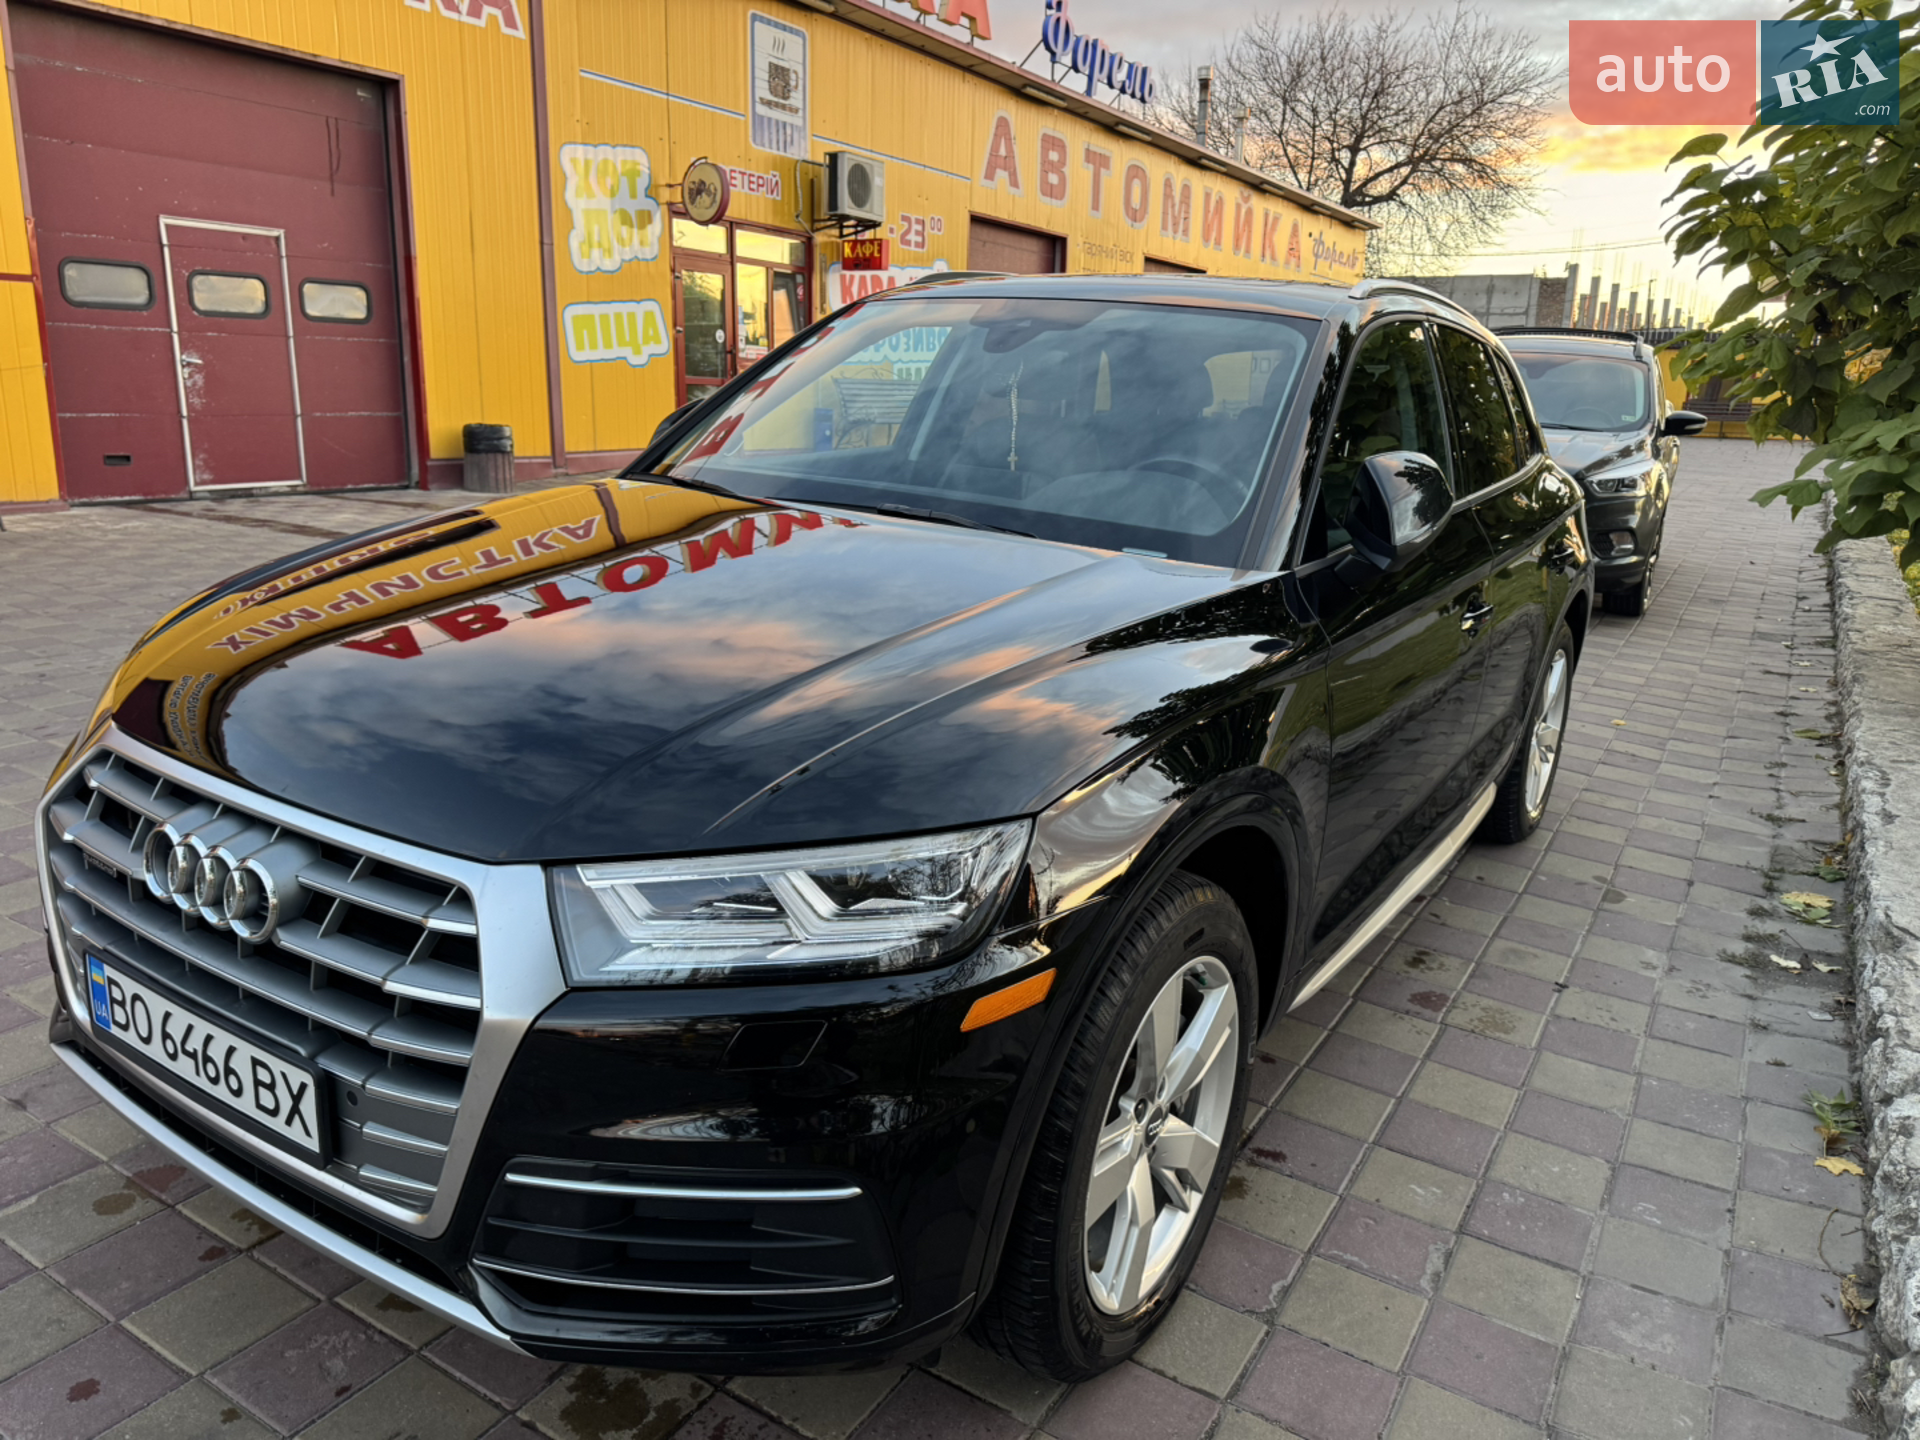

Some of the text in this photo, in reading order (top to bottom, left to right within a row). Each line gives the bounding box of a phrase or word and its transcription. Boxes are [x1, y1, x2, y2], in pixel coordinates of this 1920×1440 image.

[569, 156, 643, 199] ХОТ
[727, 167, 781, 199] ЕТЕРІЙ
[979, 110, 1302, 272] АВТОМИЙКА
[579, 207, 653, 260] ДОГ
[843, 240, 881, 259] КАФЕ
[571, 310, 662, 356] ПІЦА
[95, 999, 109, 1020] UA
[161, 1010, 243, 1098] 6466
